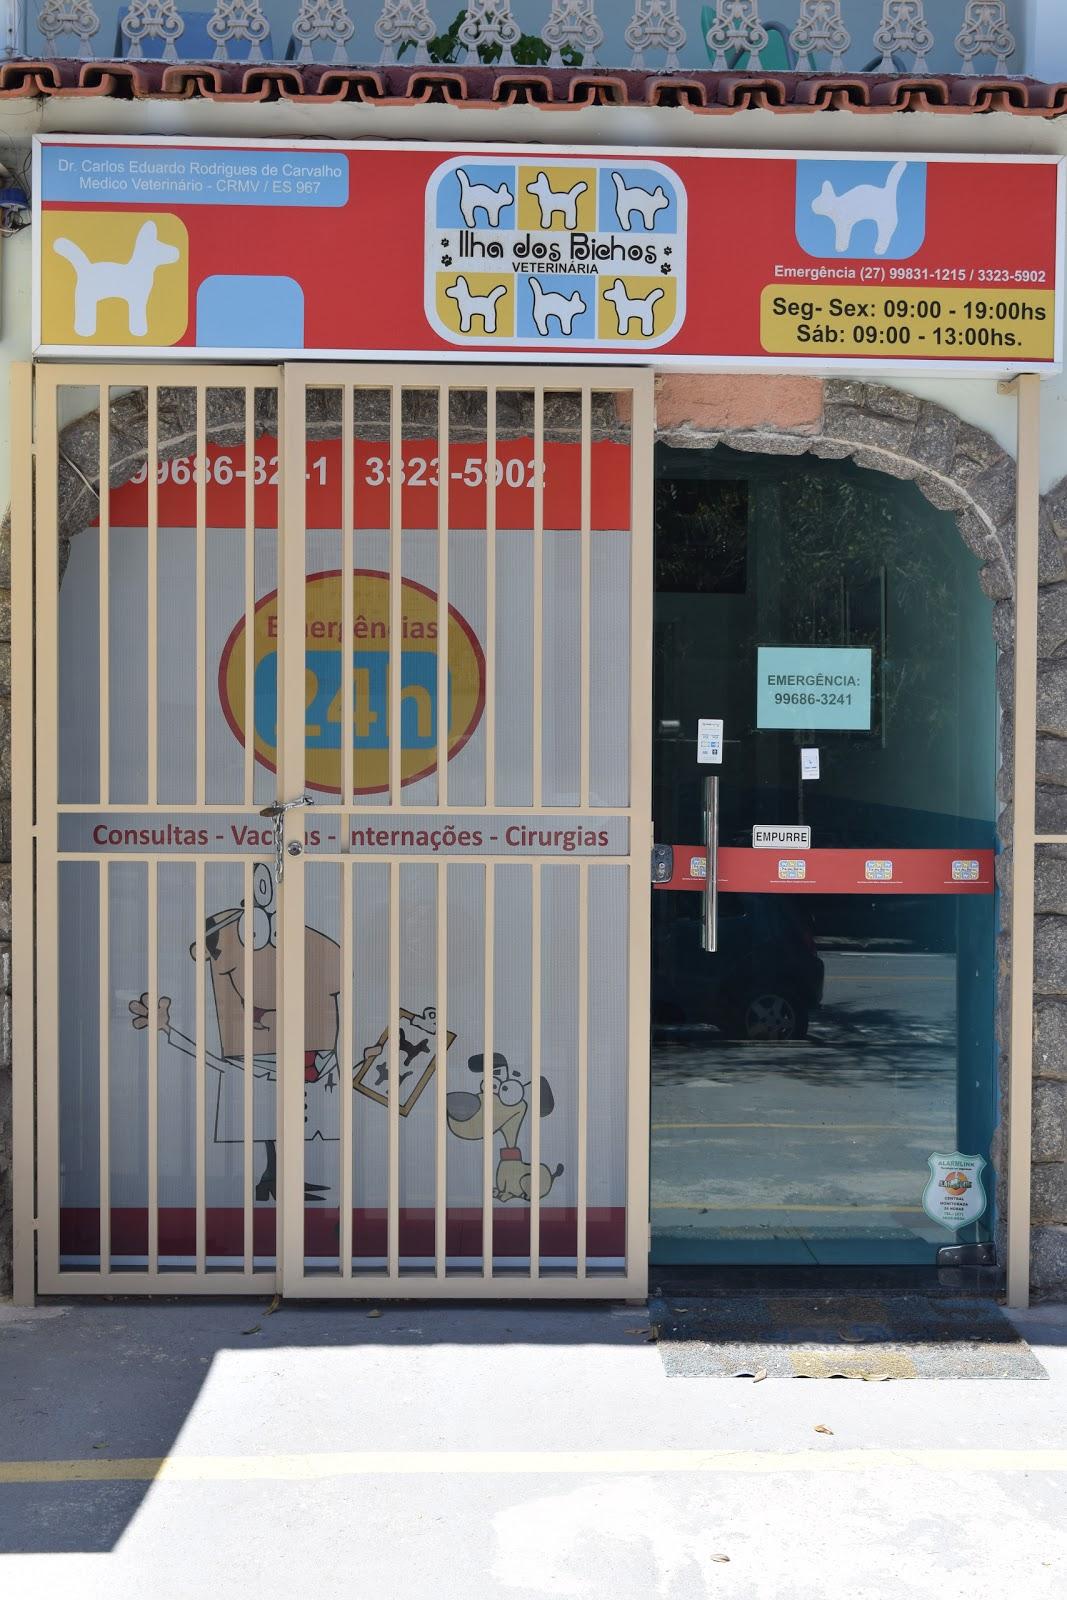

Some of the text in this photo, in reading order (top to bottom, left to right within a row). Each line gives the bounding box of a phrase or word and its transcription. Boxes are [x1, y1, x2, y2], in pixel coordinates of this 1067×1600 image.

[58, 159, 342, 178] Dr. Carlos Eduardo Rodrigues de Carvalho
[131, 178, 203, 192] Veterinário
[216, 179, 260, 193] CRMV
[263, 180, 268, 193] /
[272, 180, 292, 193] ES
[296, 181, 321, 194] 967
[459, 230, 657, 264] Ilha dos Bichos
[512, 261, 598, 274] VETERINÁRIA
[774, 264, 1046, 283] Emergência (27) 99831-1215 / 3323-5902
[772, 297, 822, 320] Seg-
[828, 298, 876, 318] Sex:
[883, 299, 942, 319] 09:00
[963, 301, 1046, 321] 19:00hs
[796, 323, 845, 343] Sáb:
[853, 325, 911, 344] 09:00
[932, 327, 1022, 346] 13:00hs.
[129, 455, 327, 486] 9686-321
[267, 615, 438, 643] Eerênias
[767, 673, 860, 687] EMERGÊNCIA:
[775, 693, 852, 705] 99686-3241
[93, 824, 209, 846] Consultas
[231, 825, 320, 846] Vacs
[350, 825, 483, 850] nternações
[505, 825, 609, 851] Cirurgias
[756, 832, 807, 842] EMPURRE
